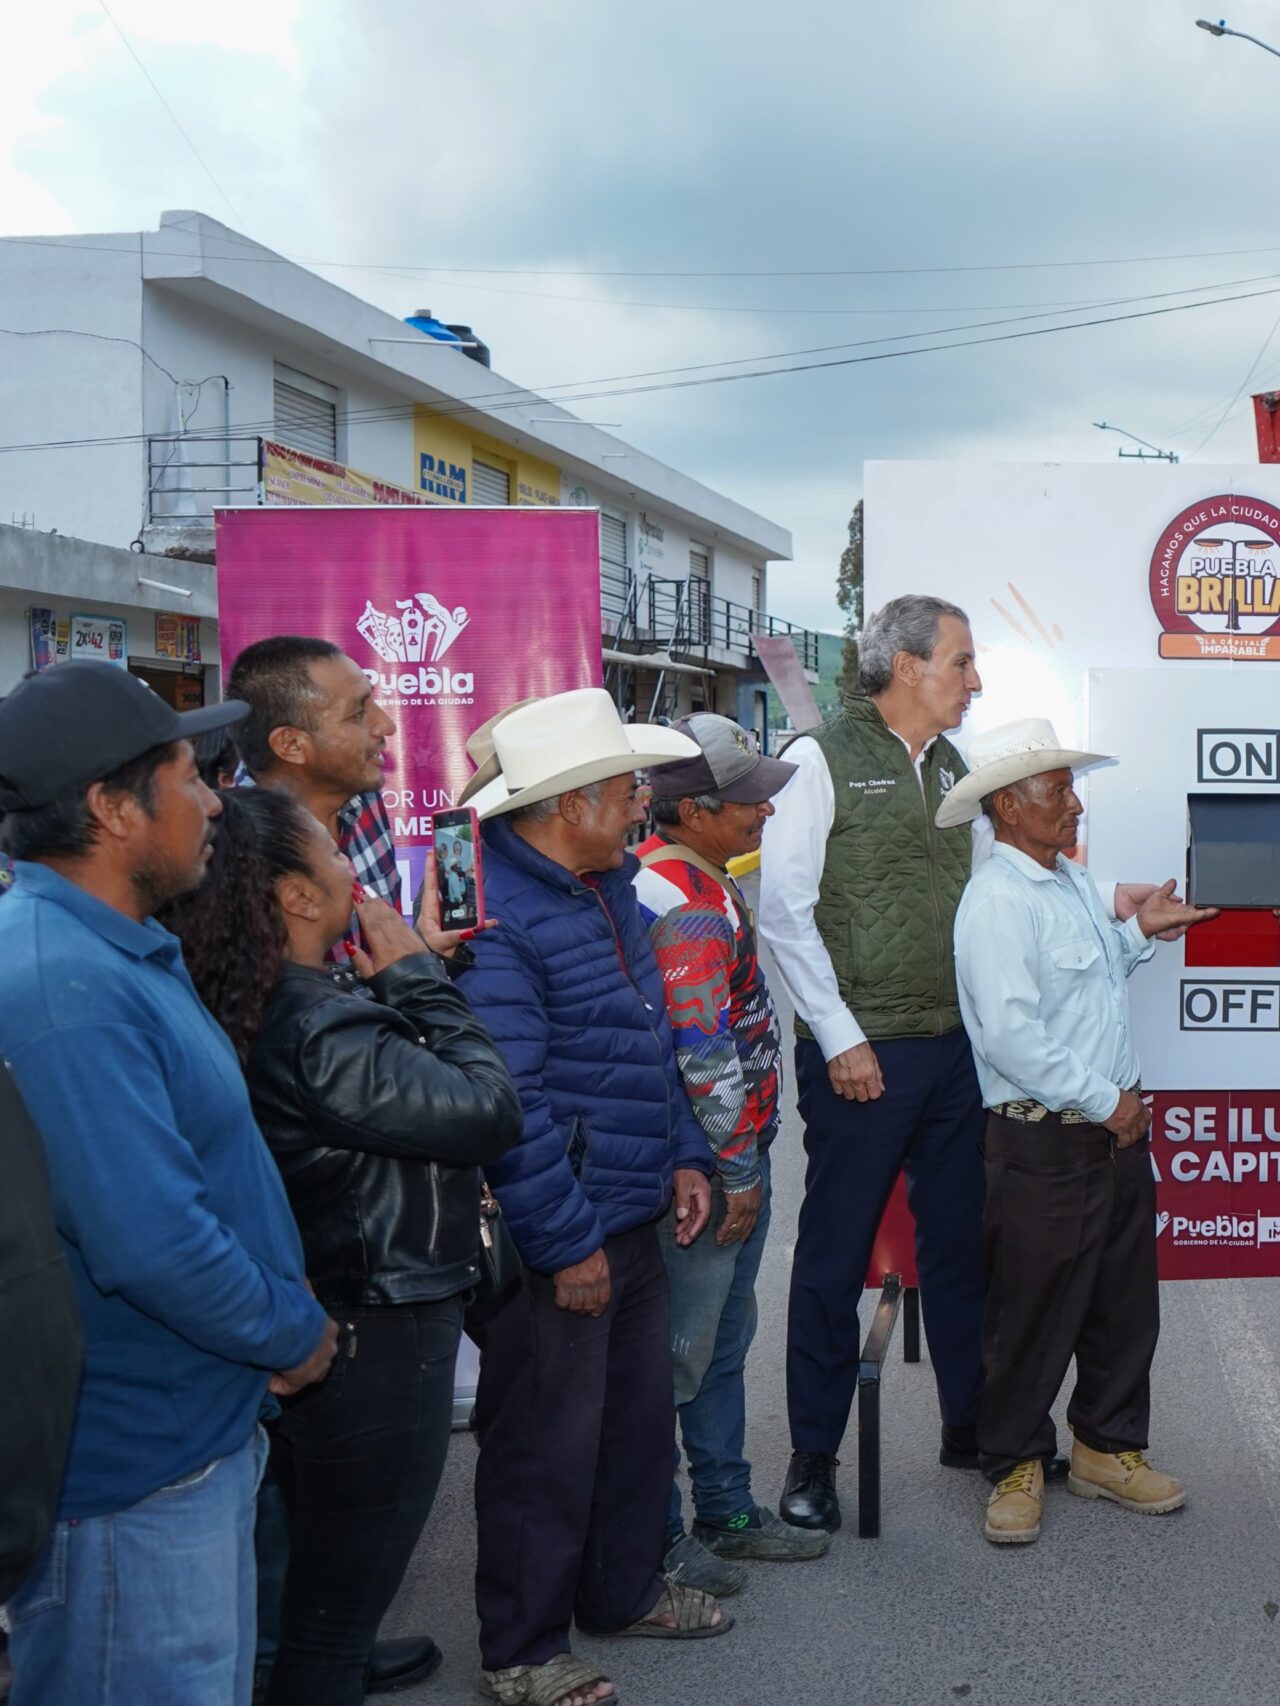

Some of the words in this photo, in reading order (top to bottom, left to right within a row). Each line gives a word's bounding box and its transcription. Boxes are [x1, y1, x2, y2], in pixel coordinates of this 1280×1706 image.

[420, 452, 467, 504] RAM
[1160, 532, 1184, 597] HAGAMOS
[1183, 512, 1208, 532] QUE
[1211, 506, 1227, 516] LA
[1231, 505, 1279, 529] CIUDAD
[1191, 557, 1277, 577] PUEBLA
[75, 630, 104, 649] 2X$42
[1201, 645, 1267, 656] IMPARABLE
[1221, 638, 1261, 647] CAPITAL
[362, 667, 474, 695] Puebla
[1209, 741, 1272, 777] ON
[381, 790, 415, 809] OR
[422, 789, 454, 808] UN
[1184, 988, 1275, 1024] OFF
[1164, 1106, 1217, 1142] SE
[1172, 1215, 1255, 1238] Puebla
